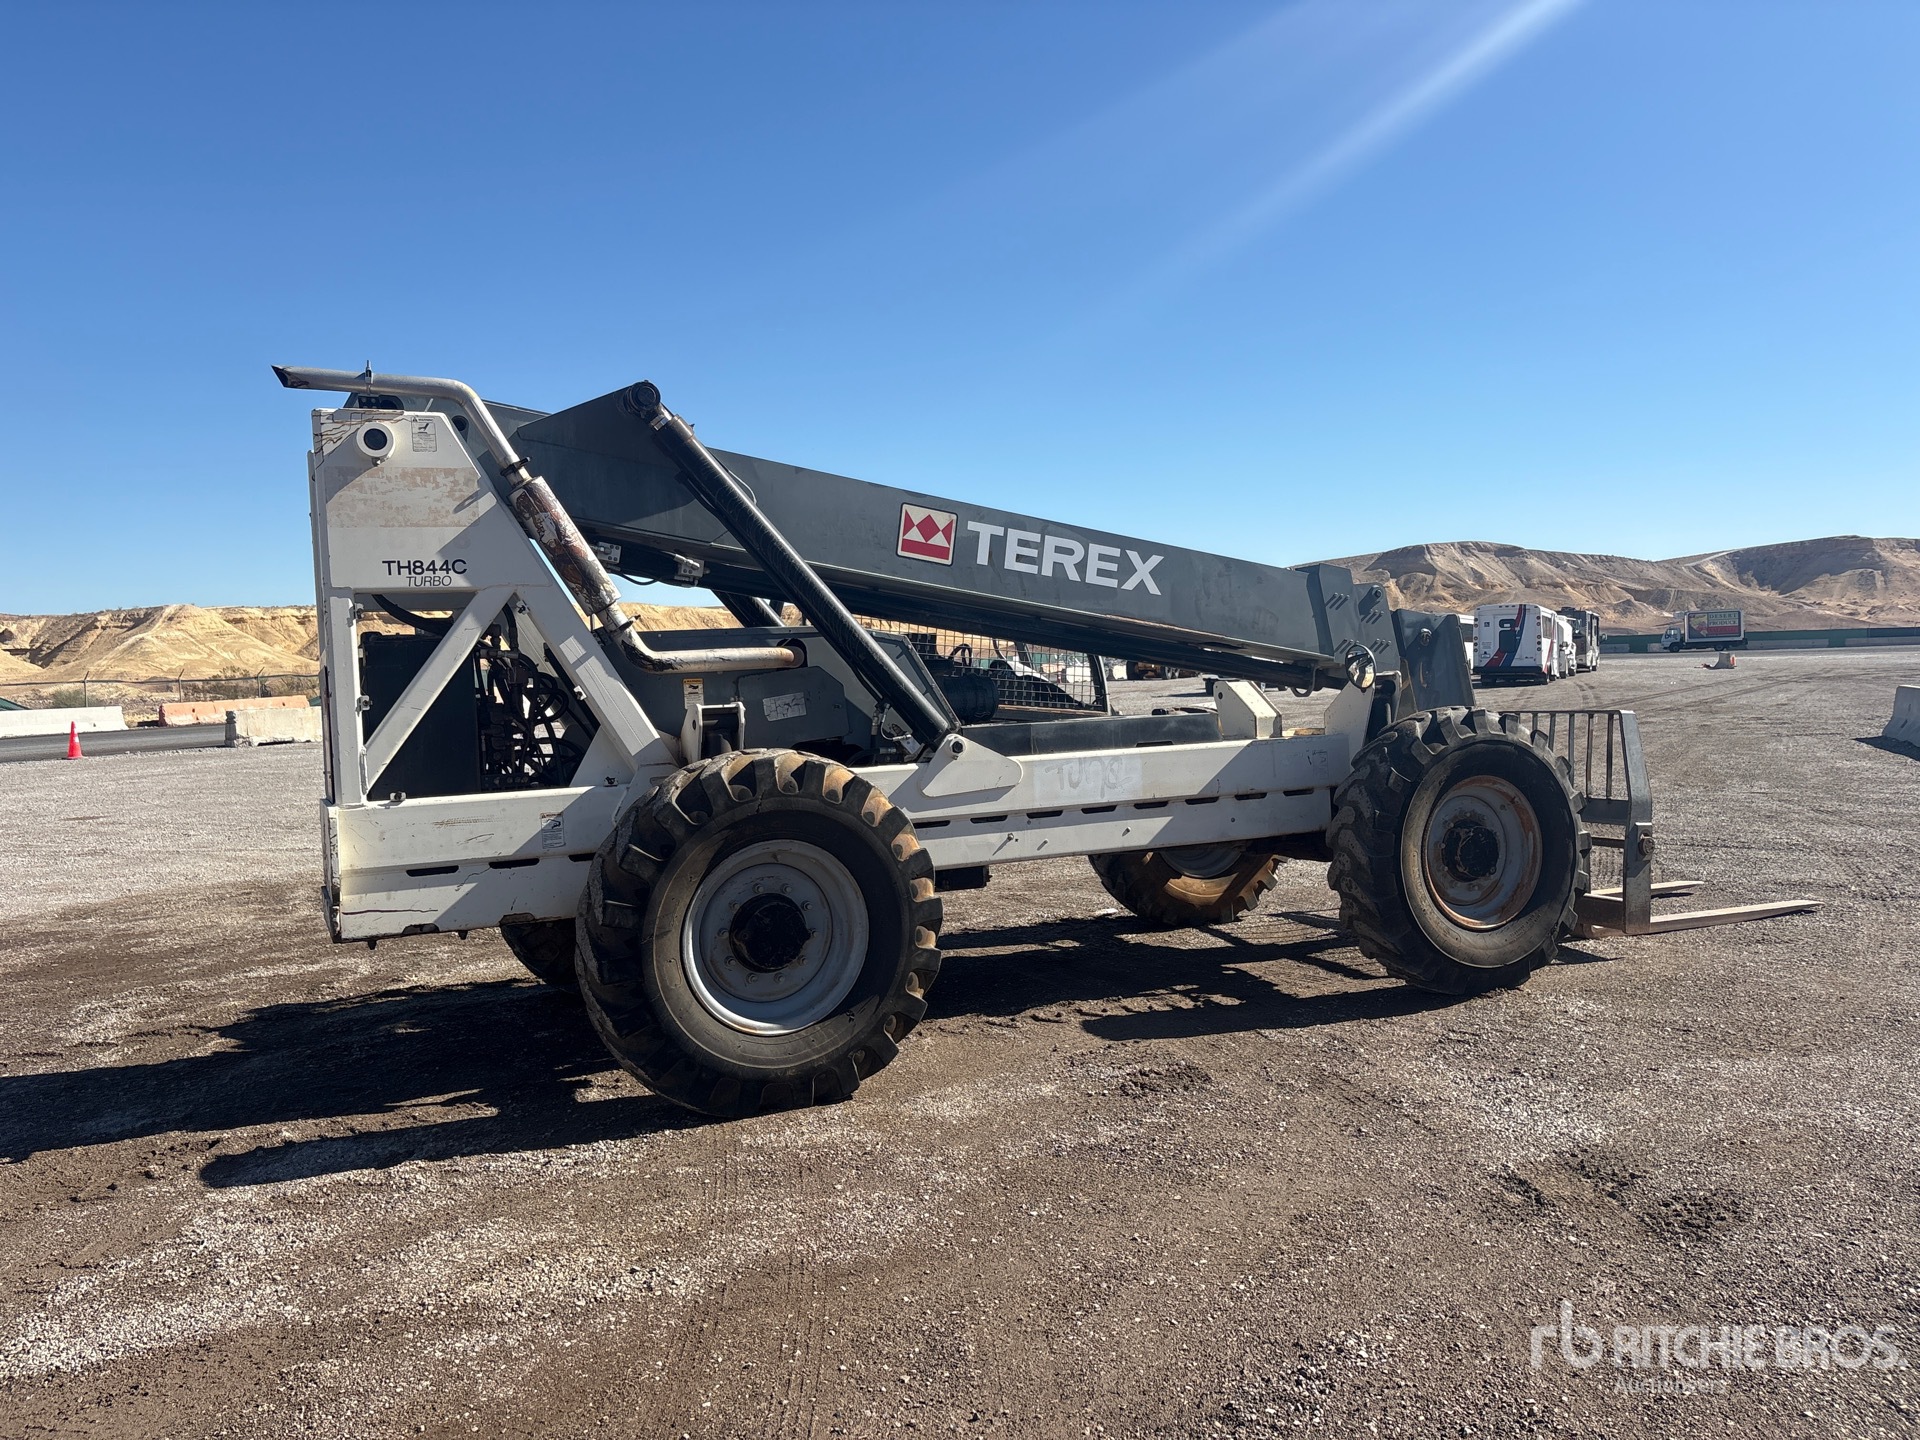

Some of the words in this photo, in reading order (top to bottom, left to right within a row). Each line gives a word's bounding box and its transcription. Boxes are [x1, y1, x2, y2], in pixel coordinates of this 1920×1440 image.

[967, 520, 1165, 596] TEREX
[382, 559, 467, 576] TH844C
[406, 575, 452, 587] TURBO
